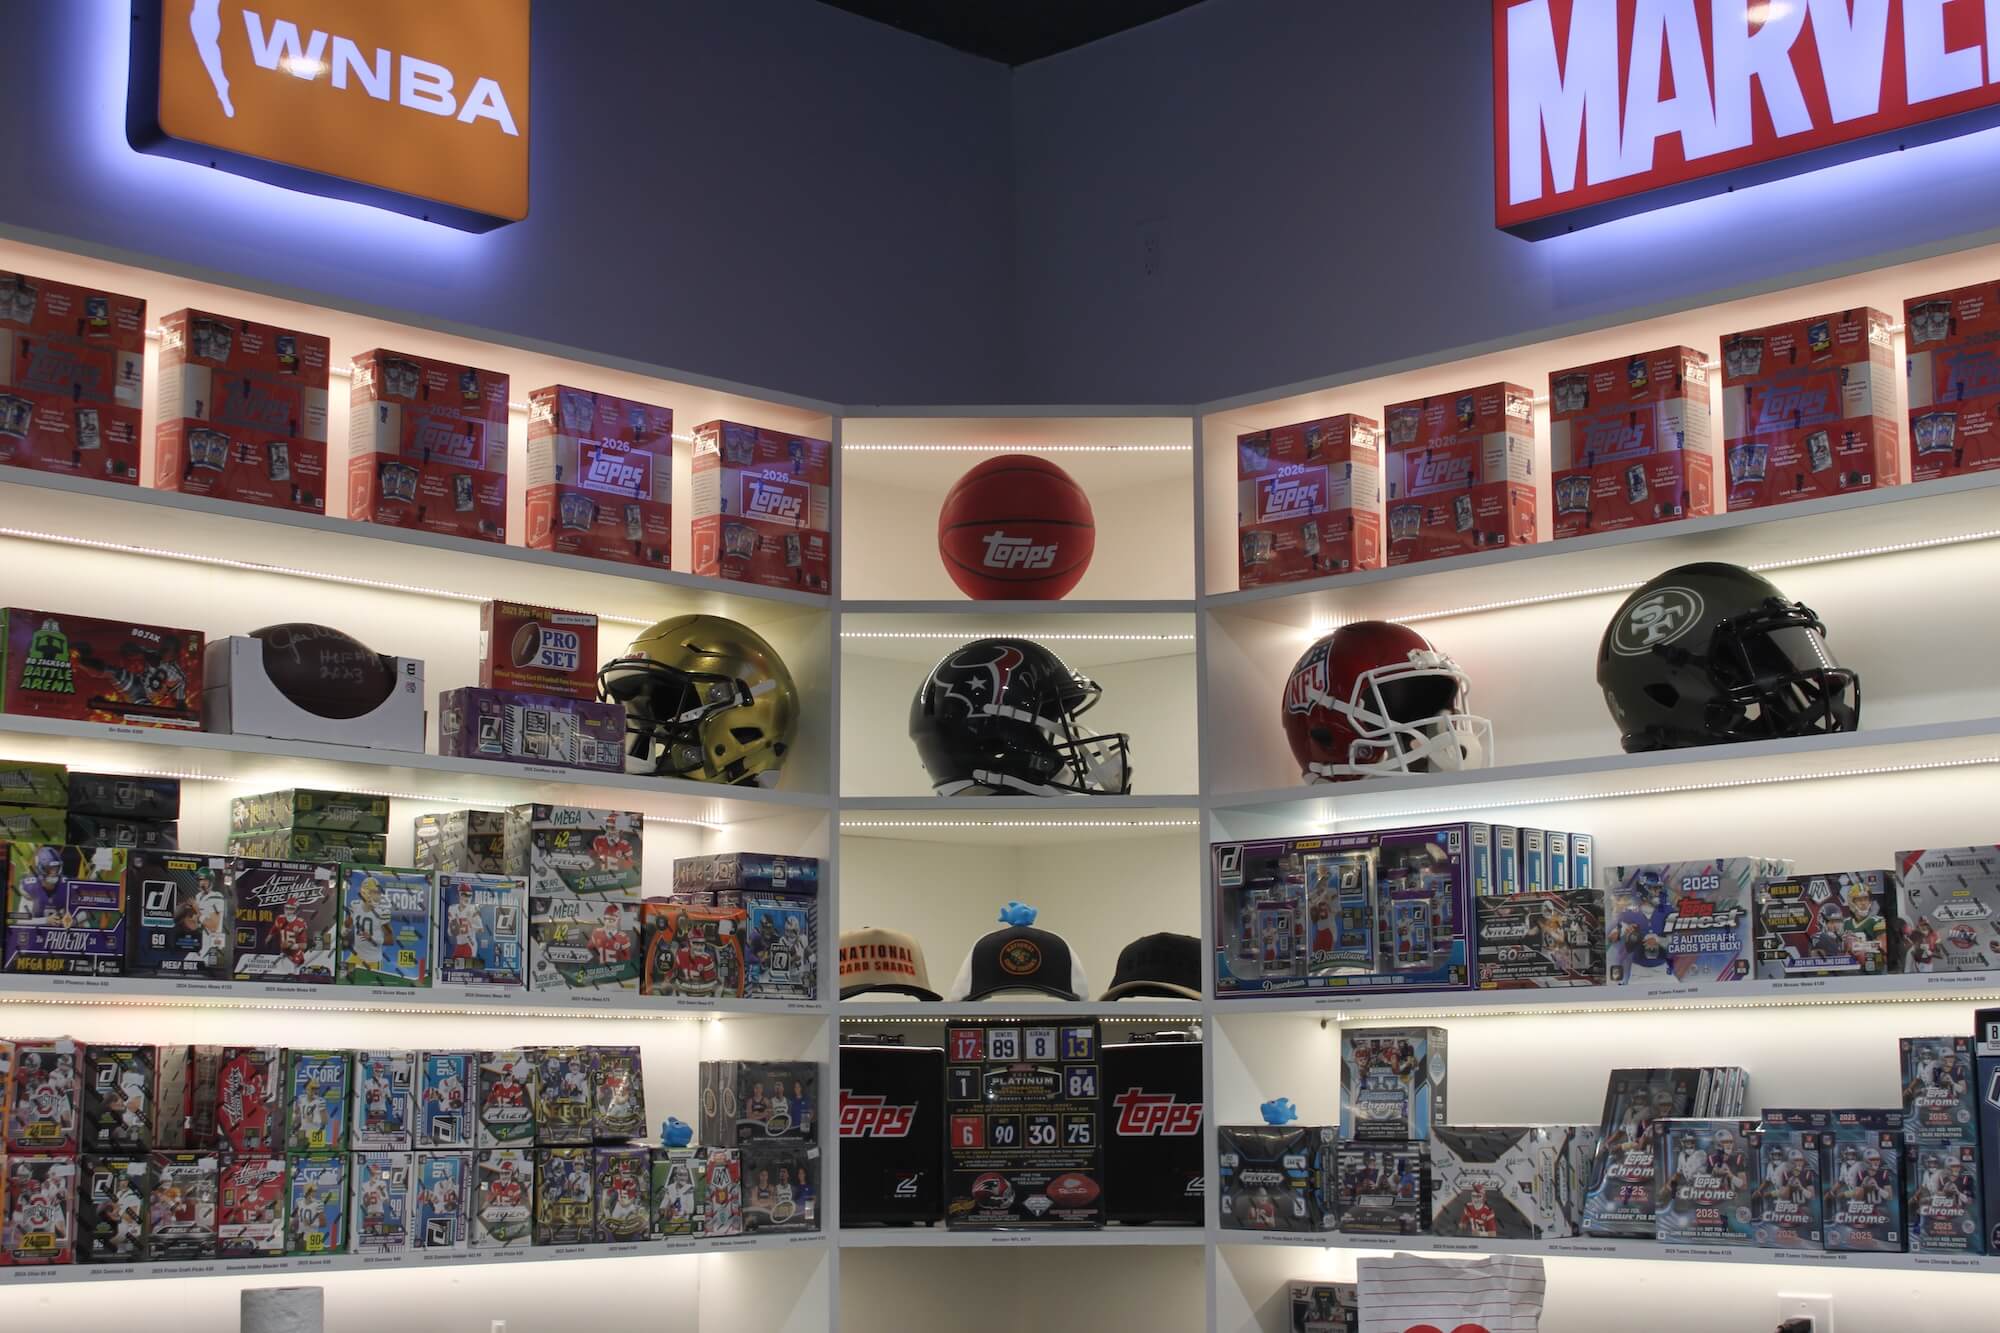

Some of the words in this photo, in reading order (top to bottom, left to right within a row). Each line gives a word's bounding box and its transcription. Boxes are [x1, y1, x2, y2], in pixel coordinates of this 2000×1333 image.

[243, 10, 519, 136] WNBA
[1507, 0, 2000, 205] MARVE
[1757, 385, 1829, 426] Topps
[601, 437, 631, 452] 2026
[1428, 436, 1457, 449] 2026
[1583, 419, 1645, 457] Topps
[586, 449, 645, 486] Topps
[1278, 463, 1305, 478] 2026
[1412, 455, 1471, 486] Topps
[762, 470, 790, 484] 2026
[748, 479, 802, 517] Topps
[1264, 478, 1319, 514] Topps
[982, 530, 1058, 569] Topps
[541, 630, 577, 649] PRO
[541, 650, 577, 669] SET
[23, 665, 73, 680] BATTLE
[19, 678, 76, 693] ARENA
[1290, 664, 1323, 705] NFL
[552, 809, 582, 826] MEGA
[554, 831, 569, 848] 42
[1682, 875, 1720, 891] 2025
[552, 903, 581, 920] MEGA
[1679, 897, 1714, 916] Topps
[44, 931, 90, 951] PHOENIX
[152, 933, 166, 946] 60
[553, 925, 569, 942] 42
[1672, 935, 1679, 945] 2
[503, 943, 517, 956] 60
[839, 945, 912, 962] NATIONAL
[1498, 949, 1518, 961] 60
[1668, 943, 1699, 954] CARDS
[1700, 942, 1718, 953] PER
[1719, 941, 1741, 951] BOX!
[17, 958, 43, 970] MEGA
[45, 958, 65, 970] BOX
[957, 1038, 976, 1059] 17
[993, 1039, 1015, 1058] 89
[1035, 1038, 1046, 1057] 8
[1068, 1038, 1088, 1057] 13
[960, 1078, 967, 1097] 1
[991, 1077, 1054, 1086] PLATINUM
[1069, 1075, 1095, 1096] 84
[1926, 1087, 1948, 1099] Topps
[1915, 1097, 1960, 1106] Chrome
[840, 1089, 918, 1138] Topps
[1113, 1087, 1203, 1136] Topps
[1839, 1113, 1856, 1122] 2025
[311, 1130, 323, 1142] 90
[962, 1126, 974, 1145] 6
[995, 1125, 1014, 1144] 90
[1028, 1125, 1056, 1145] 30
[1067, 1124, 1091, 1144] 75
[1623, 1151, 1654, 1165] Topps
[1607, 1164, 1654, 1177] Chrom
[1694, 1173, 1722, 1188] Topps
[1680, 1187, 1734, 1200] Chrome
[1775, 1200, 1798, 1213] Topps
[1847, 1200, 1874, 1214] Topps
[1931, 1196, 1953, 1208] Topps
[1696, 1208, 1720, 1218] 2025
[1762, 1211, 1809, 1224] Chrome
[1835, 1212, 1886, 1224] Chrome
[1920, 1206, 1965, 1217] Chrome
[310, 1234, 321, 1246] 90
[1851, 1231, 1873, 1241] 2025
